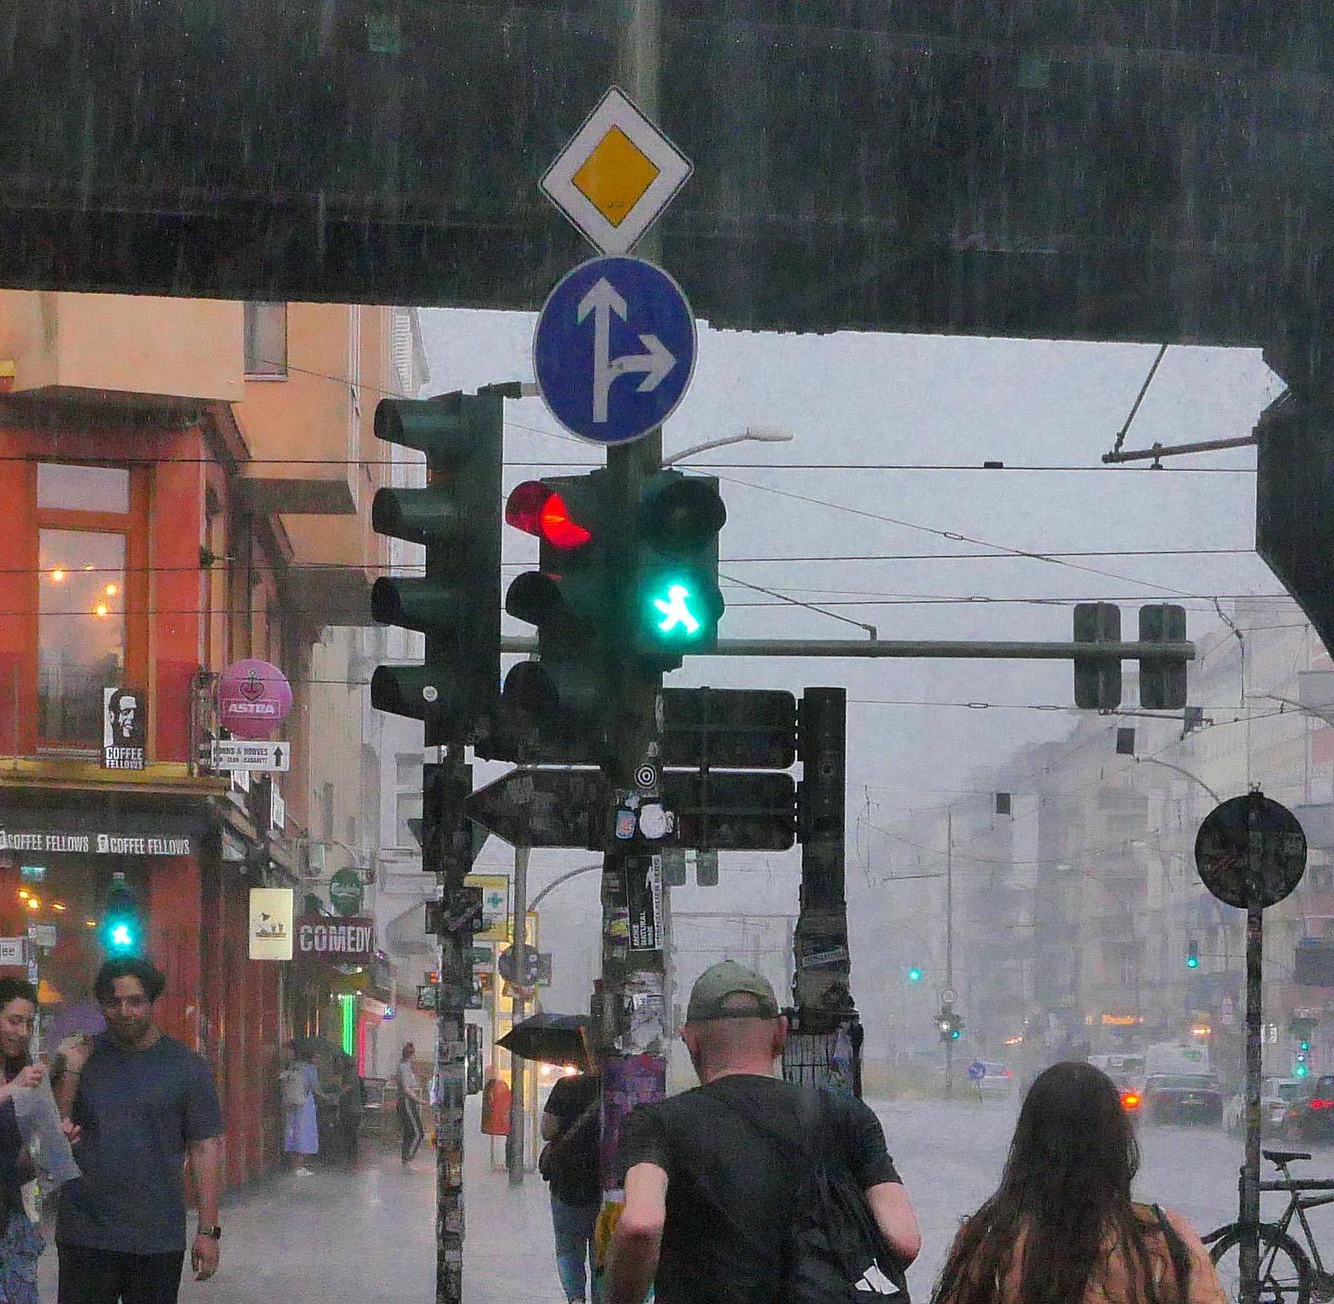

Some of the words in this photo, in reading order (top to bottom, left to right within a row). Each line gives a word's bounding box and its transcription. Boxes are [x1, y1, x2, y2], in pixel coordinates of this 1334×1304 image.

[105, 747, 144, 760] COFFEE
[105, 760, 144, 770] FELLOWS
[7, 834, 42, 851] COFFEE
[45, 835, 89, 852] FELLOWS
[109, 837, 145, 854] COFFEE
[148, 838, 190, 855] FELLOWS
[299, 924, 371, 953] COMEDY
